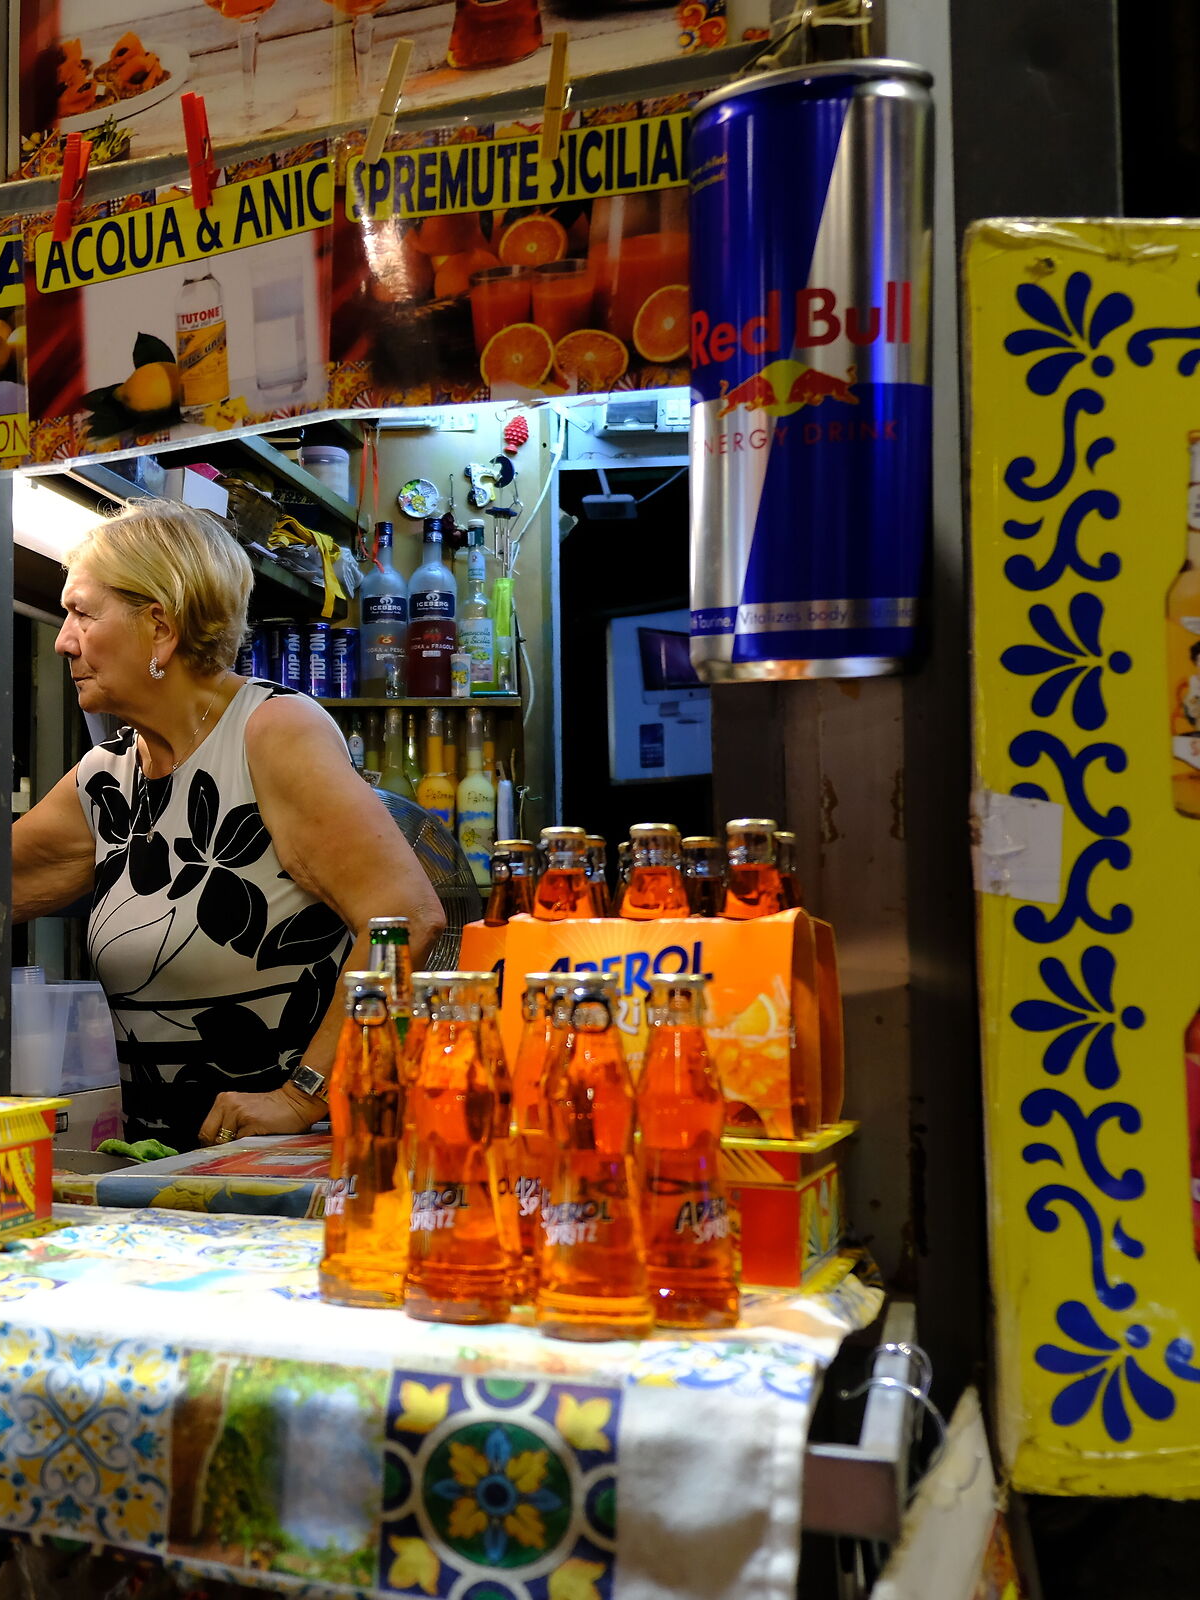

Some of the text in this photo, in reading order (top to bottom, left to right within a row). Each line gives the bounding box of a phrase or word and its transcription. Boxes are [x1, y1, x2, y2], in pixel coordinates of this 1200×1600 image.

[353, 138, 537, 214] SPREMUTE
[551, 116, 689, 194] SICILIA
[42, 163, 332, 289] ACQUA & ANIC
[180, 306, 220, 325] TUTONE
[691, 281, 911, 369] Red Bull
[694, 420, 898, 456] NERGY DRINK
[808, 605, 849, 625] body
[288, 633, 300, 680] HOP ON
[309, 633, 326, 680] HOP ON
